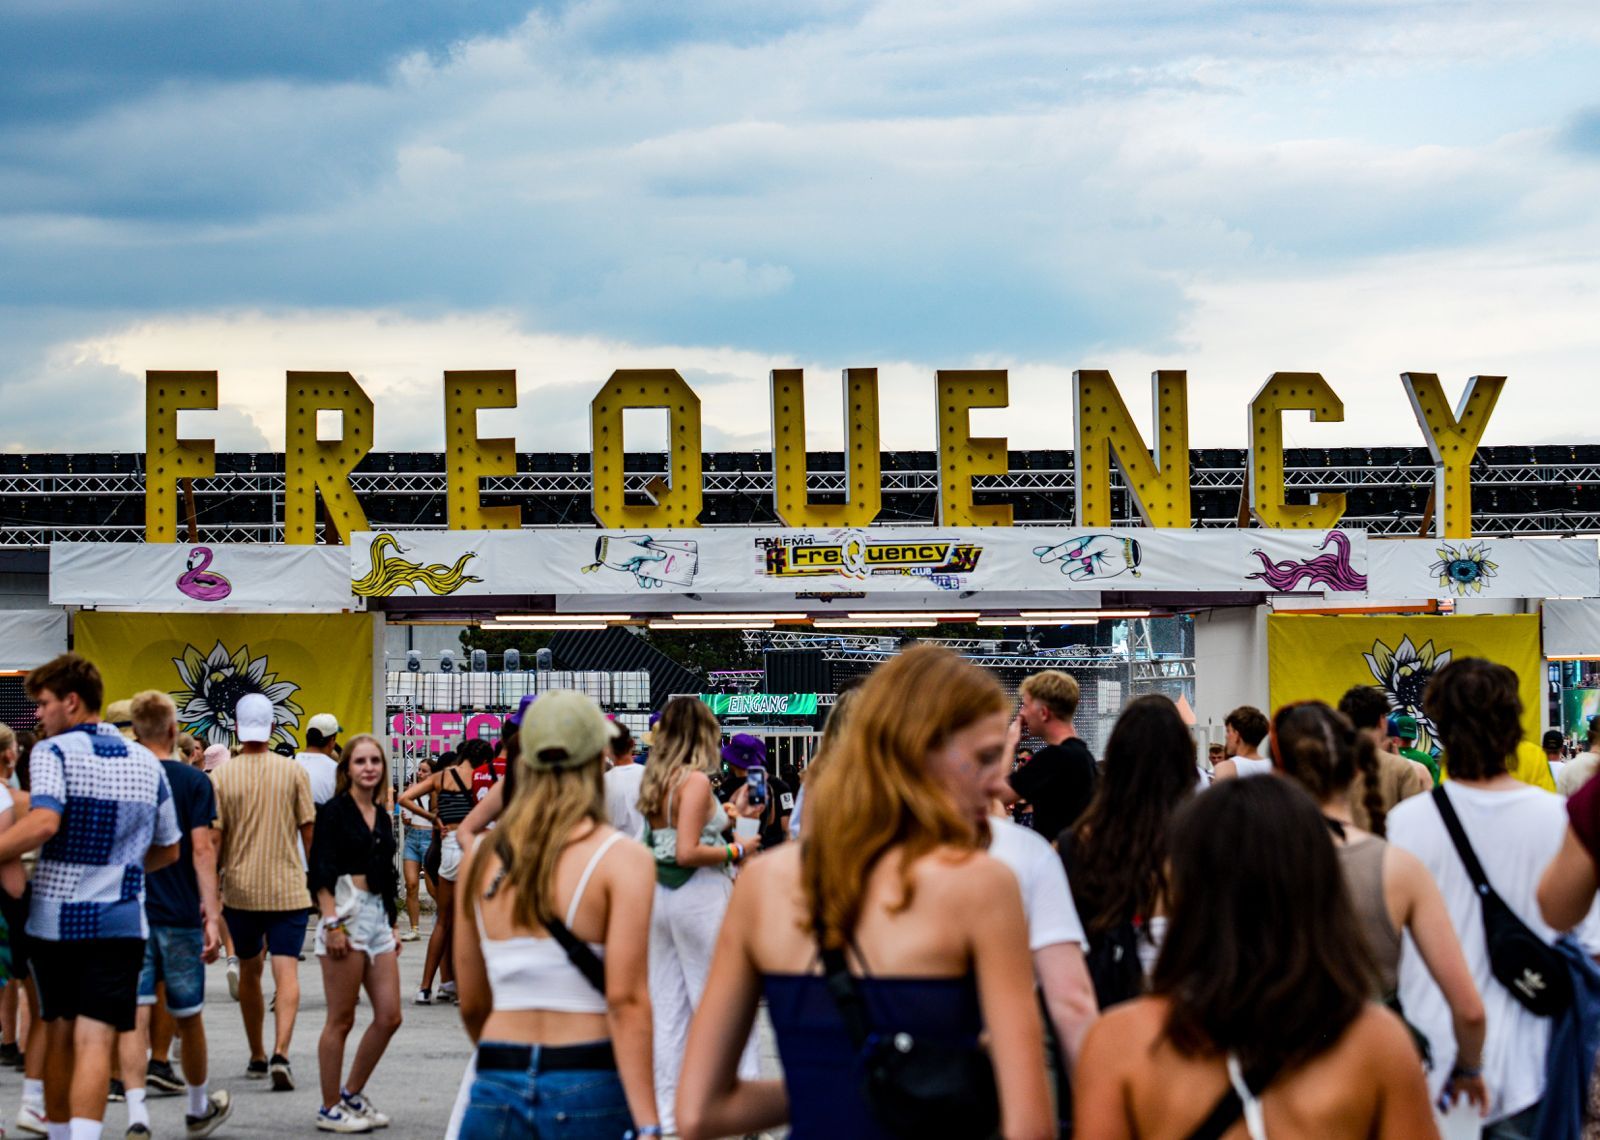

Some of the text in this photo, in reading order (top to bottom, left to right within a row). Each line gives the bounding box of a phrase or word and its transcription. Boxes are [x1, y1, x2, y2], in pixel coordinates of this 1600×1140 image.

[145, 369, 1507, 543] FREQUENCY
[783, 537, 813, 546] FM4
[910, 567, 932, 576] CLUB
[728, 696, 788, 713] EINGANG
